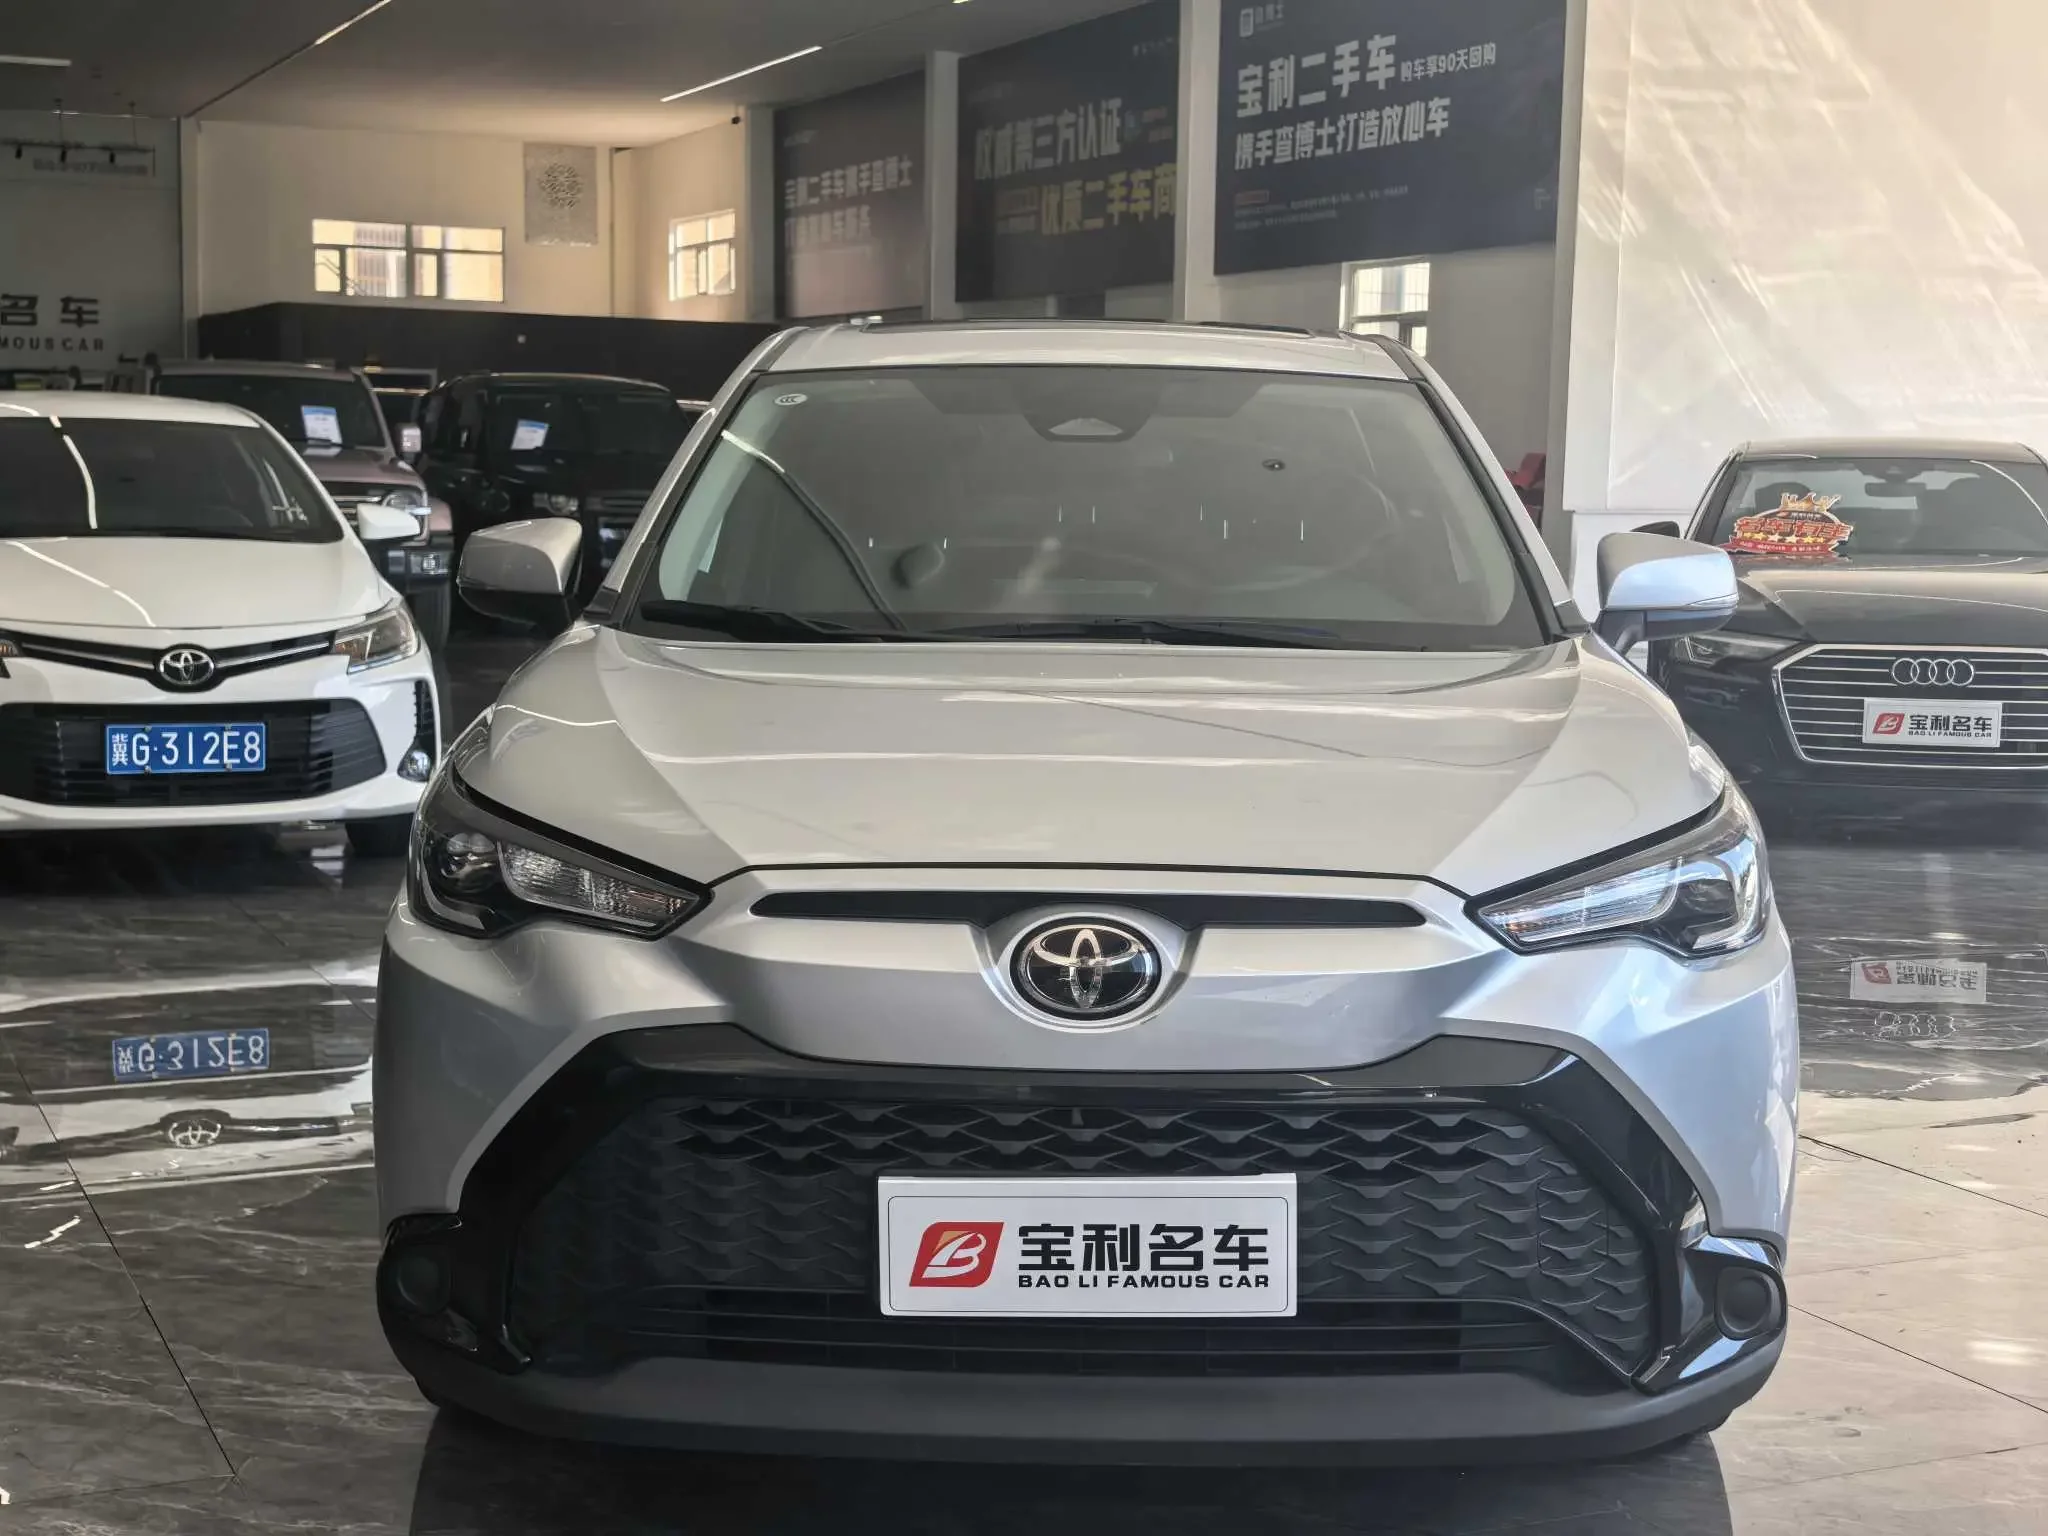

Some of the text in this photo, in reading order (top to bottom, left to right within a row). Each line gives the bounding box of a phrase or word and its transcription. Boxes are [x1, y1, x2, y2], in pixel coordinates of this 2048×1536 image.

[1236, 34, 1396, 118] 宝利二手车
[1234, 97, 1450, 170] 携手查博士打造放心车
[0, 293, 99, 329] 名车
[1908, 714, 1993, 732] 宝利名车
[1018, 1223, 1269, 1272] 宝利名车
[1018, 1275, 1269, 1289] BAO LI FAMOUS CAR
